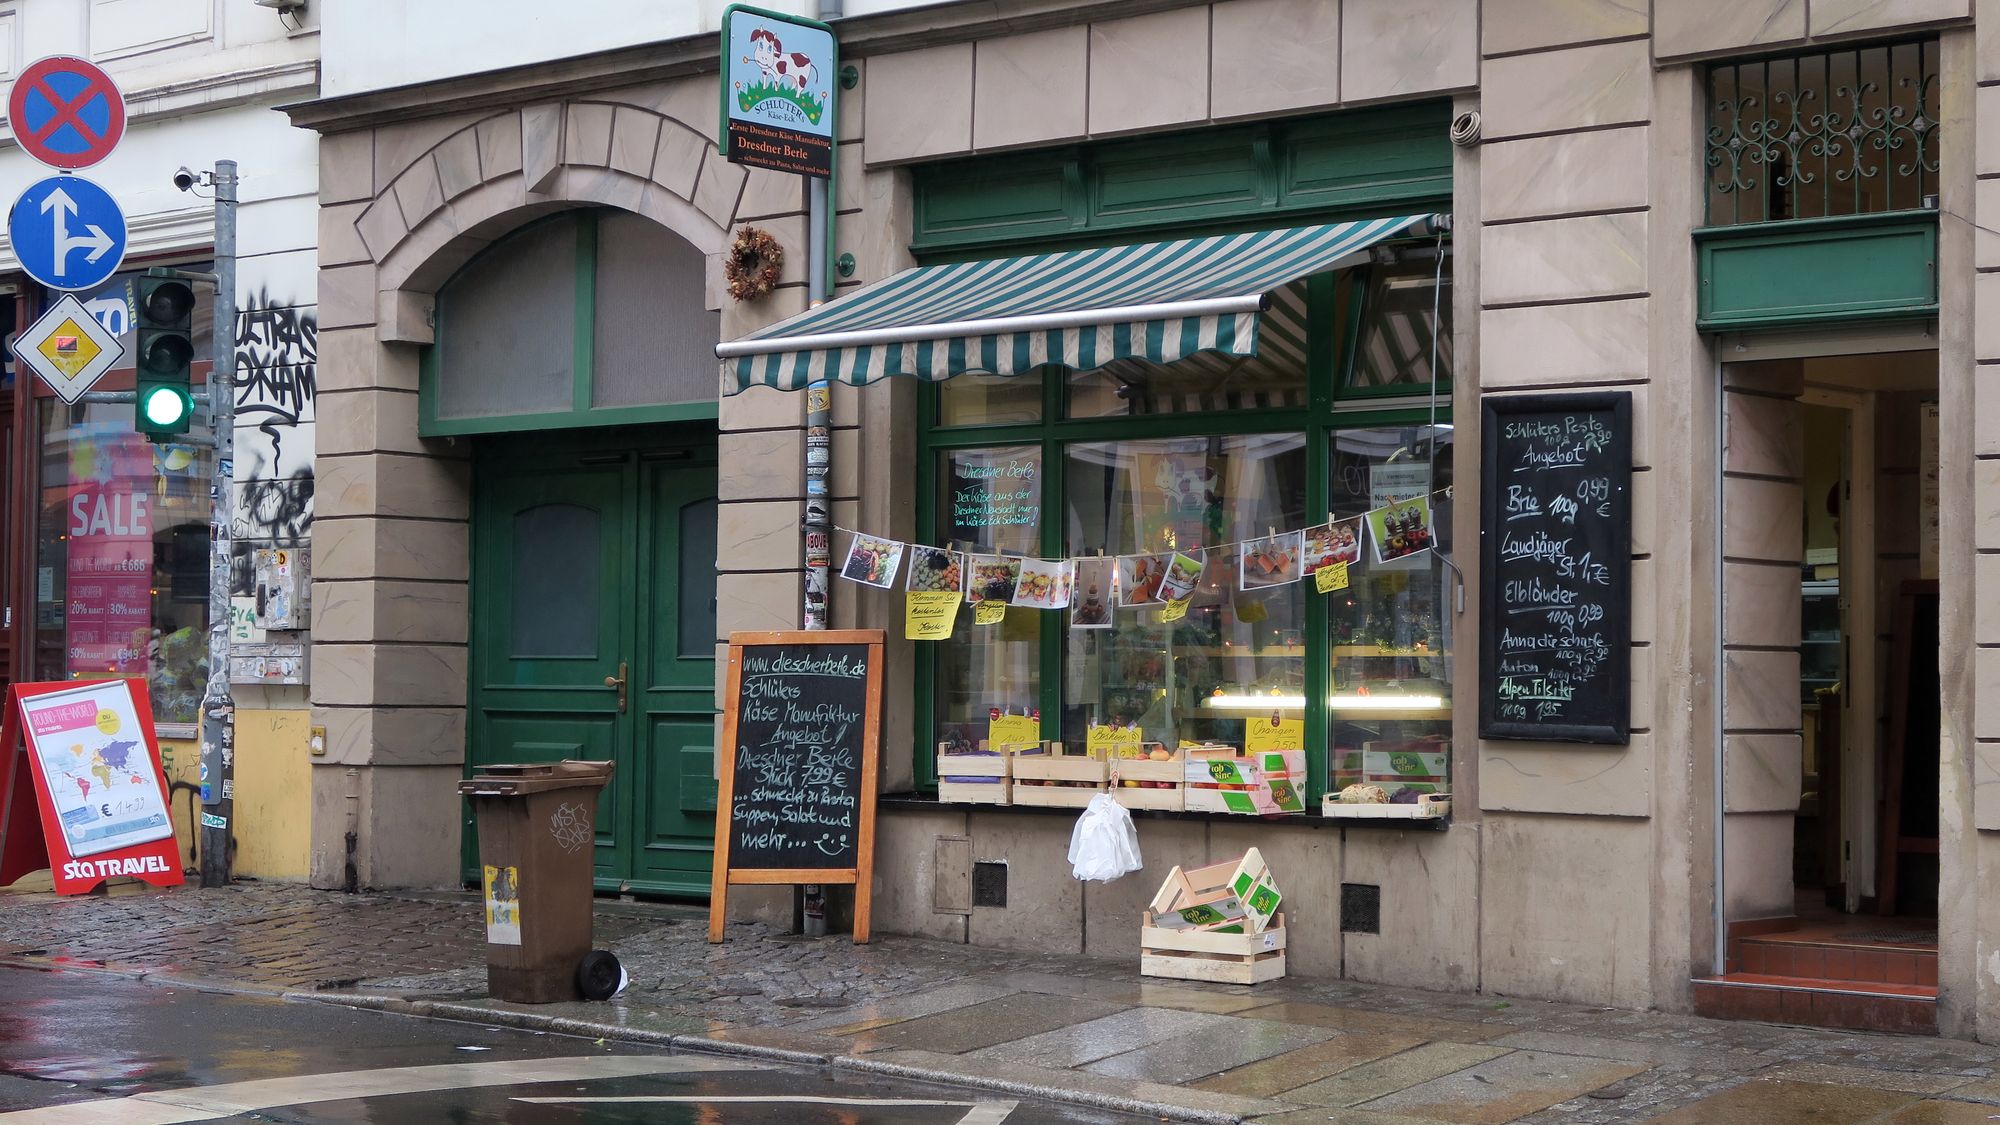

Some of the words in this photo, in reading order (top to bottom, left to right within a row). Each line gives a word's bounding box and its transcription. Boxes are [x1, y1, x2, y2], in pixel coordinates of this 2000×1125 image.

[768, 110, 795, 122] Käse-Eck
[732, 122, 748, 133] Erste
[749, 125, 778, 137] Dresdner
[779, 131, 794, 140] Käse
[795, 134, 830, 147] Manufaktur
[738, 136, 781, 155] Dresdner
[784, 145, 808, 159] Berle
[125, 279, 138, 328] TRAVEL
[1565, 414, 1602, 434] Pesto
[1522, 442, 1586, 471] Angebot
[961, 461, 1005, 479] Dresdner
[1015, 488, 1032, 499] der
[1375, 493, 1415, 501] Nacmieter
[1506, 485, 1540, 512] Brie
[1597, 502, 1611, 517] €
[71, 493, 147, 537] SALE
[1501, 530, 1573, 563] Landjäger
[1505, 577, 1578, 605] Elbländer
[71, 603, 88, 614] 20%
[110, 604, 128, 614] 30%
[1500, 628, 1536, 650] Anna
[1537, 633, 1557, 648] die
[70, 647, 86, 659] 50%
[1499, 678, 1530, 700] Alpen
[743, 700, 778, 722] Käse
[784, 701, 860, 723] Manufaktur
[1253, 719, 1296, 738] Orangen
[739, 745, 800, 769] Dresdner
[806, 745, 856, 769] Berle
[755, 767, 795, 787] Stück
[751, 787, 806, 804] schmeckt
[101, 804, 112, 817] €
[781, 804, 818, 825] Salat
[819, 811, 851, 827] und
[63, 859, 95, 880] sta
[94, 855, 170, 877] TRAVEL
